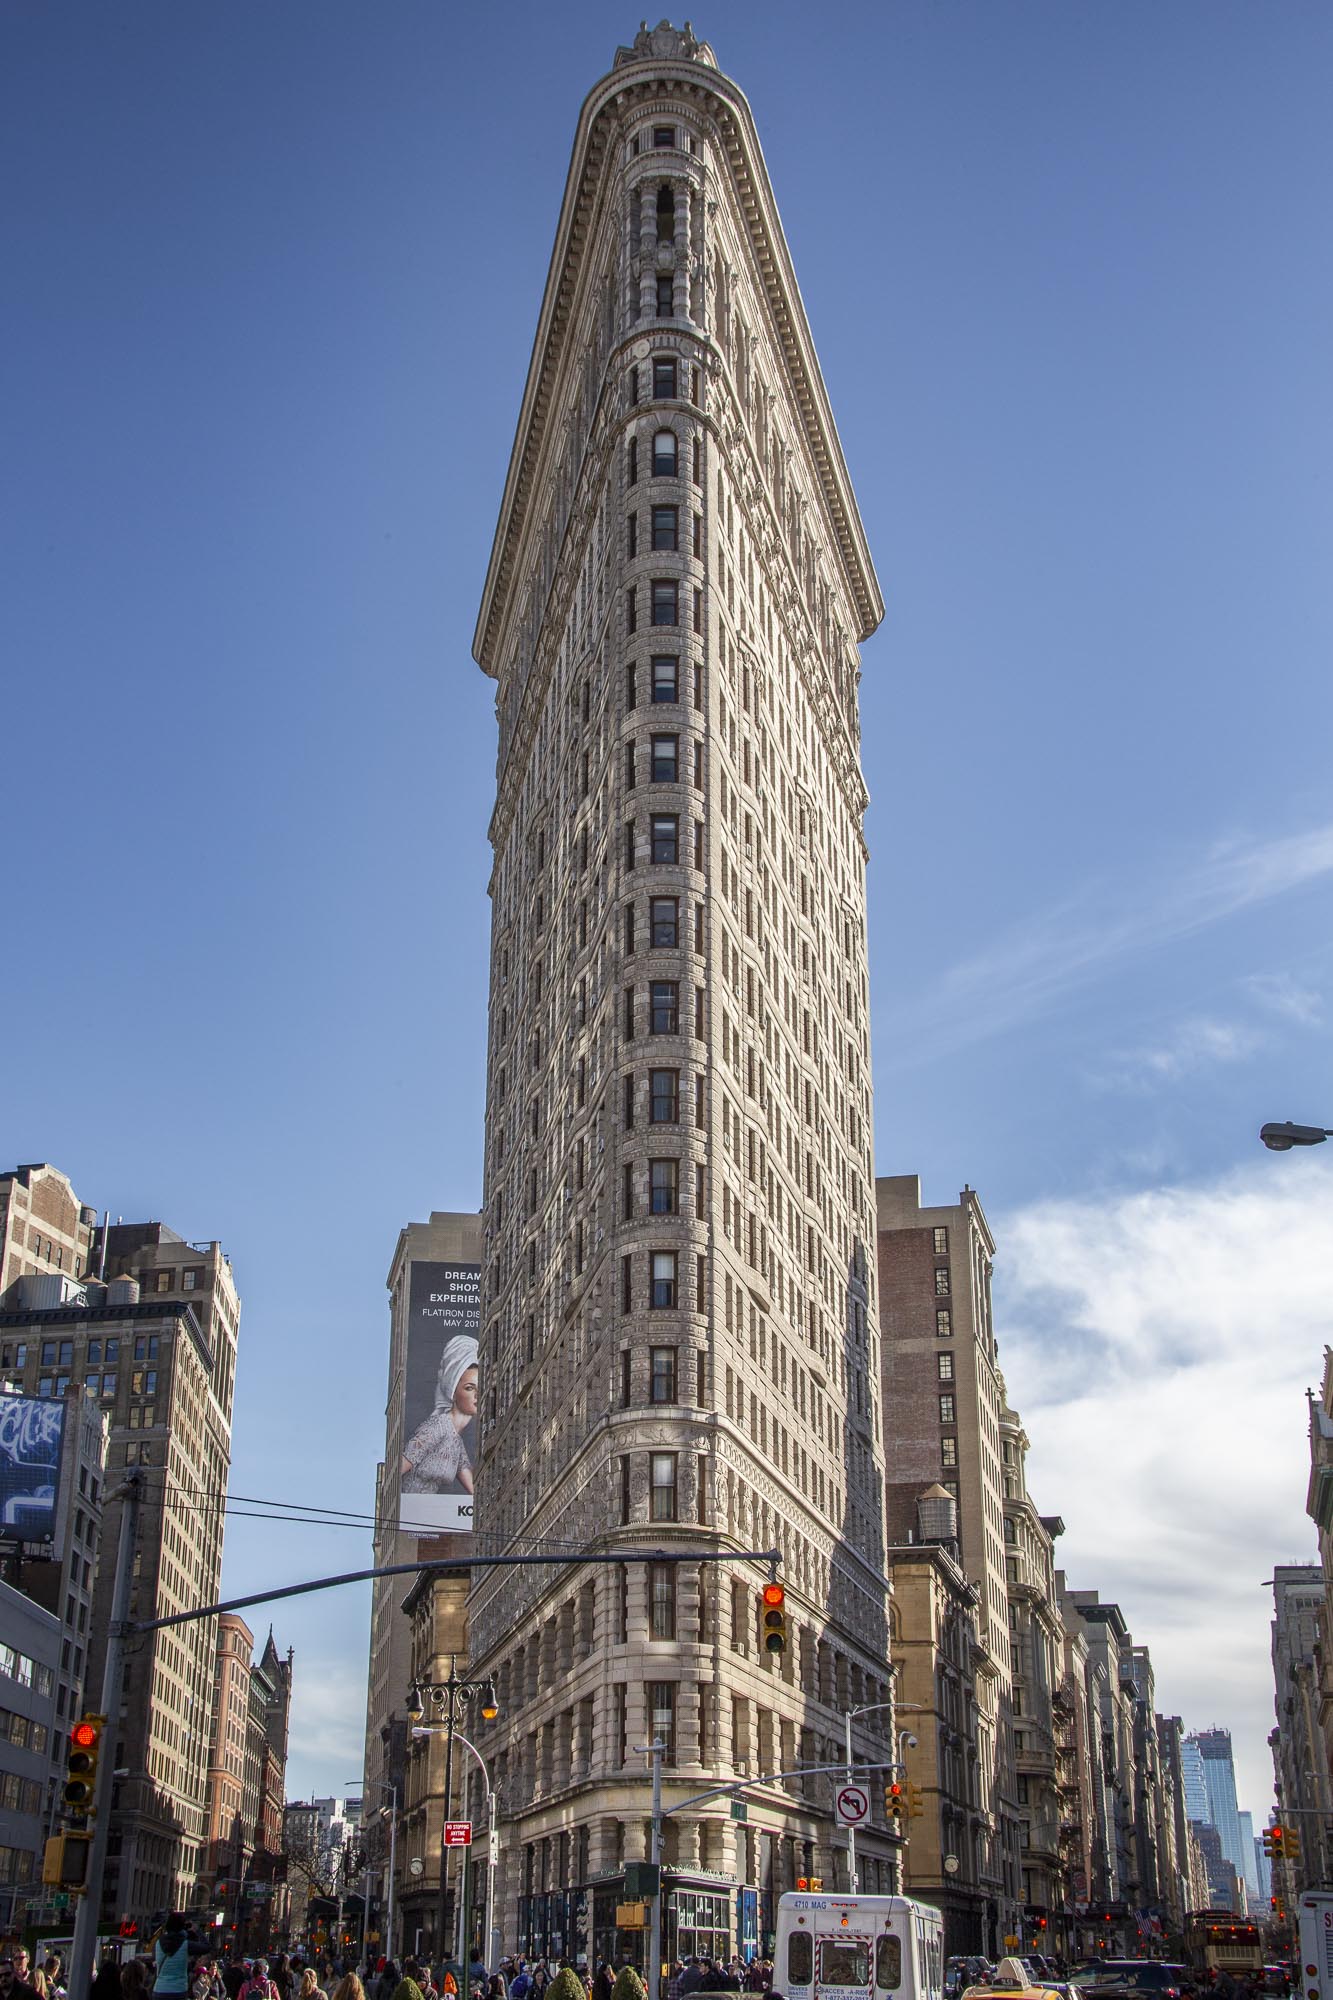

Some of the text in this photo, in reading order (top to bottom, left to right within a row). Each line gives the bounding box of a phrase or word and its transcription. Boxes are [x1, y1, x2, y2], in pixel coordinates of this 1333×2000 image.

[445, 1272, 481, 1280] DREAM
[449, 1283, 480, 1292] SHOP.
[422, 1308, 464, 1318] FLATIRON
[443, 1319, 462, 1327] MAY
[794, 1900, 827, 1910] 4710 MAG
[1324, 1912, 1333, 1928] S
